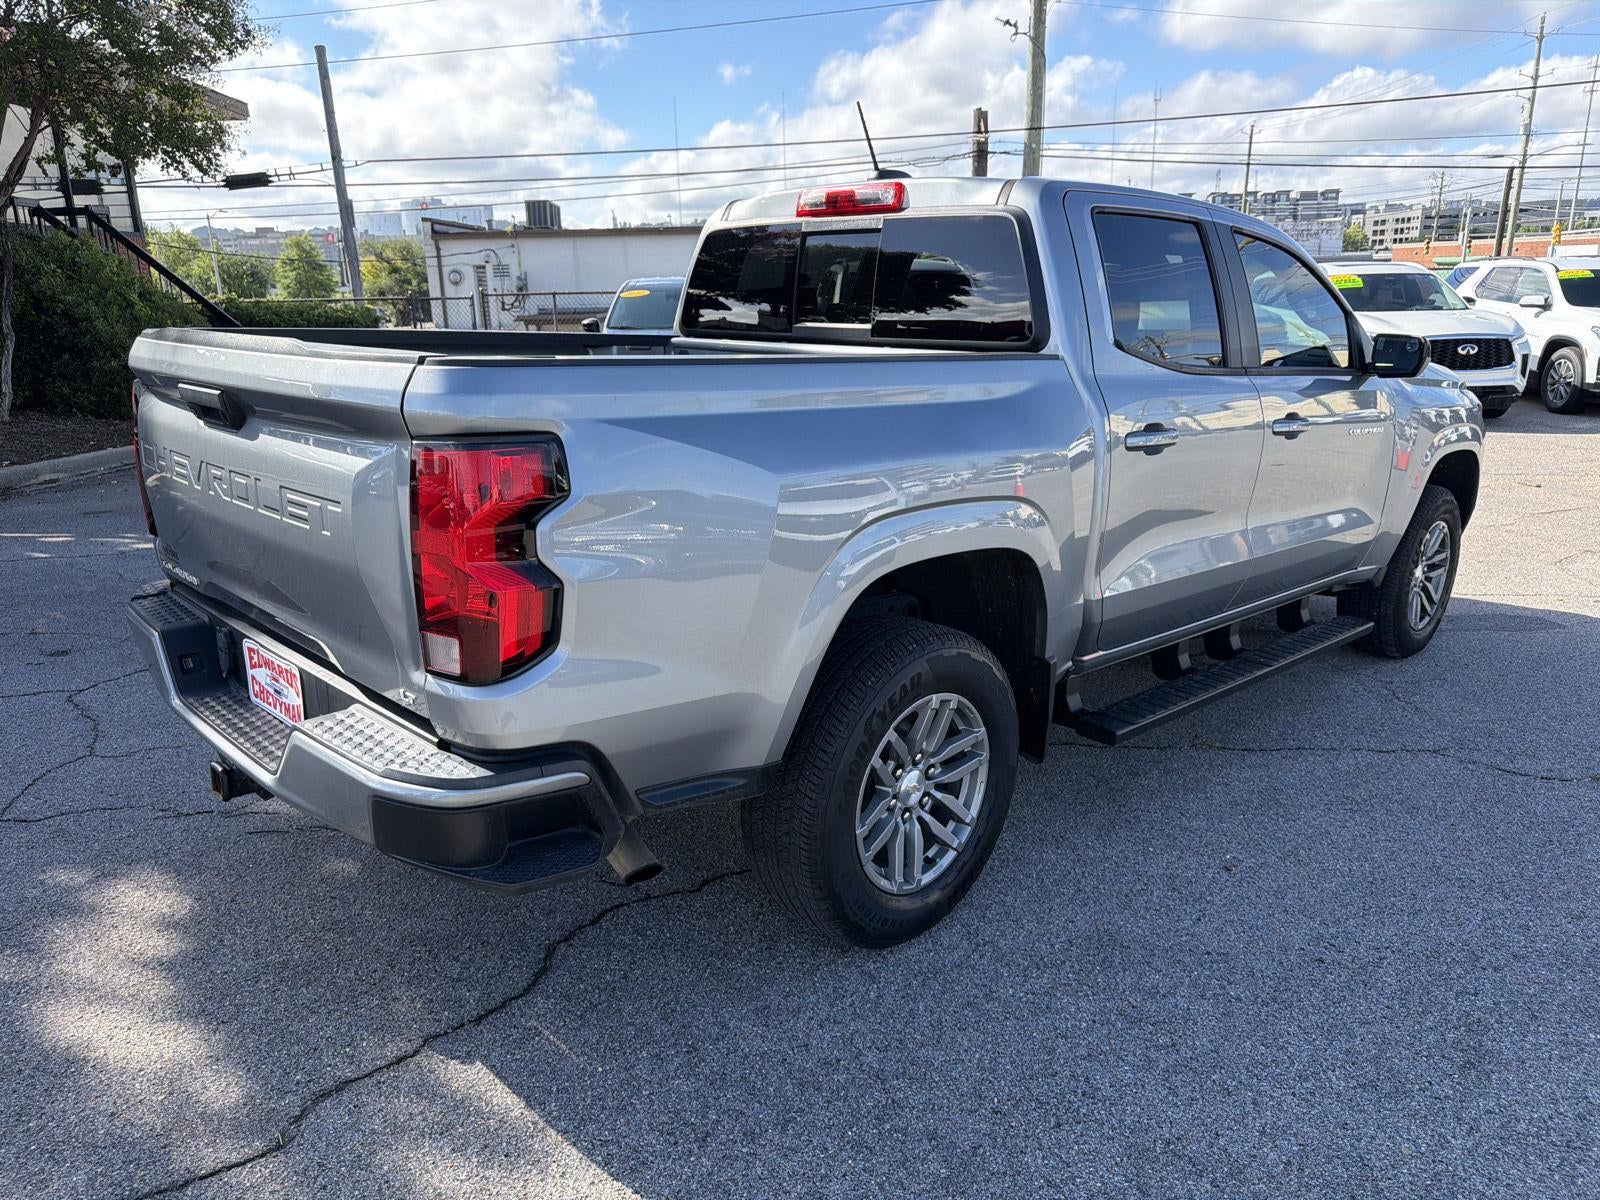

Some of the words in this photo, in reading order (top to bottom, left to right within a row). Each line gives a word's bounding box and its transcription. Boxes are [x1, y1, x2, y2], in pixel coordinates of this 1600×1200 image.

[142, 440, 341, 535] CHEVROLET
[251, 674, 302, 723] CHEVYMAN
[840, 671, 923, 811] GOODYEAR
